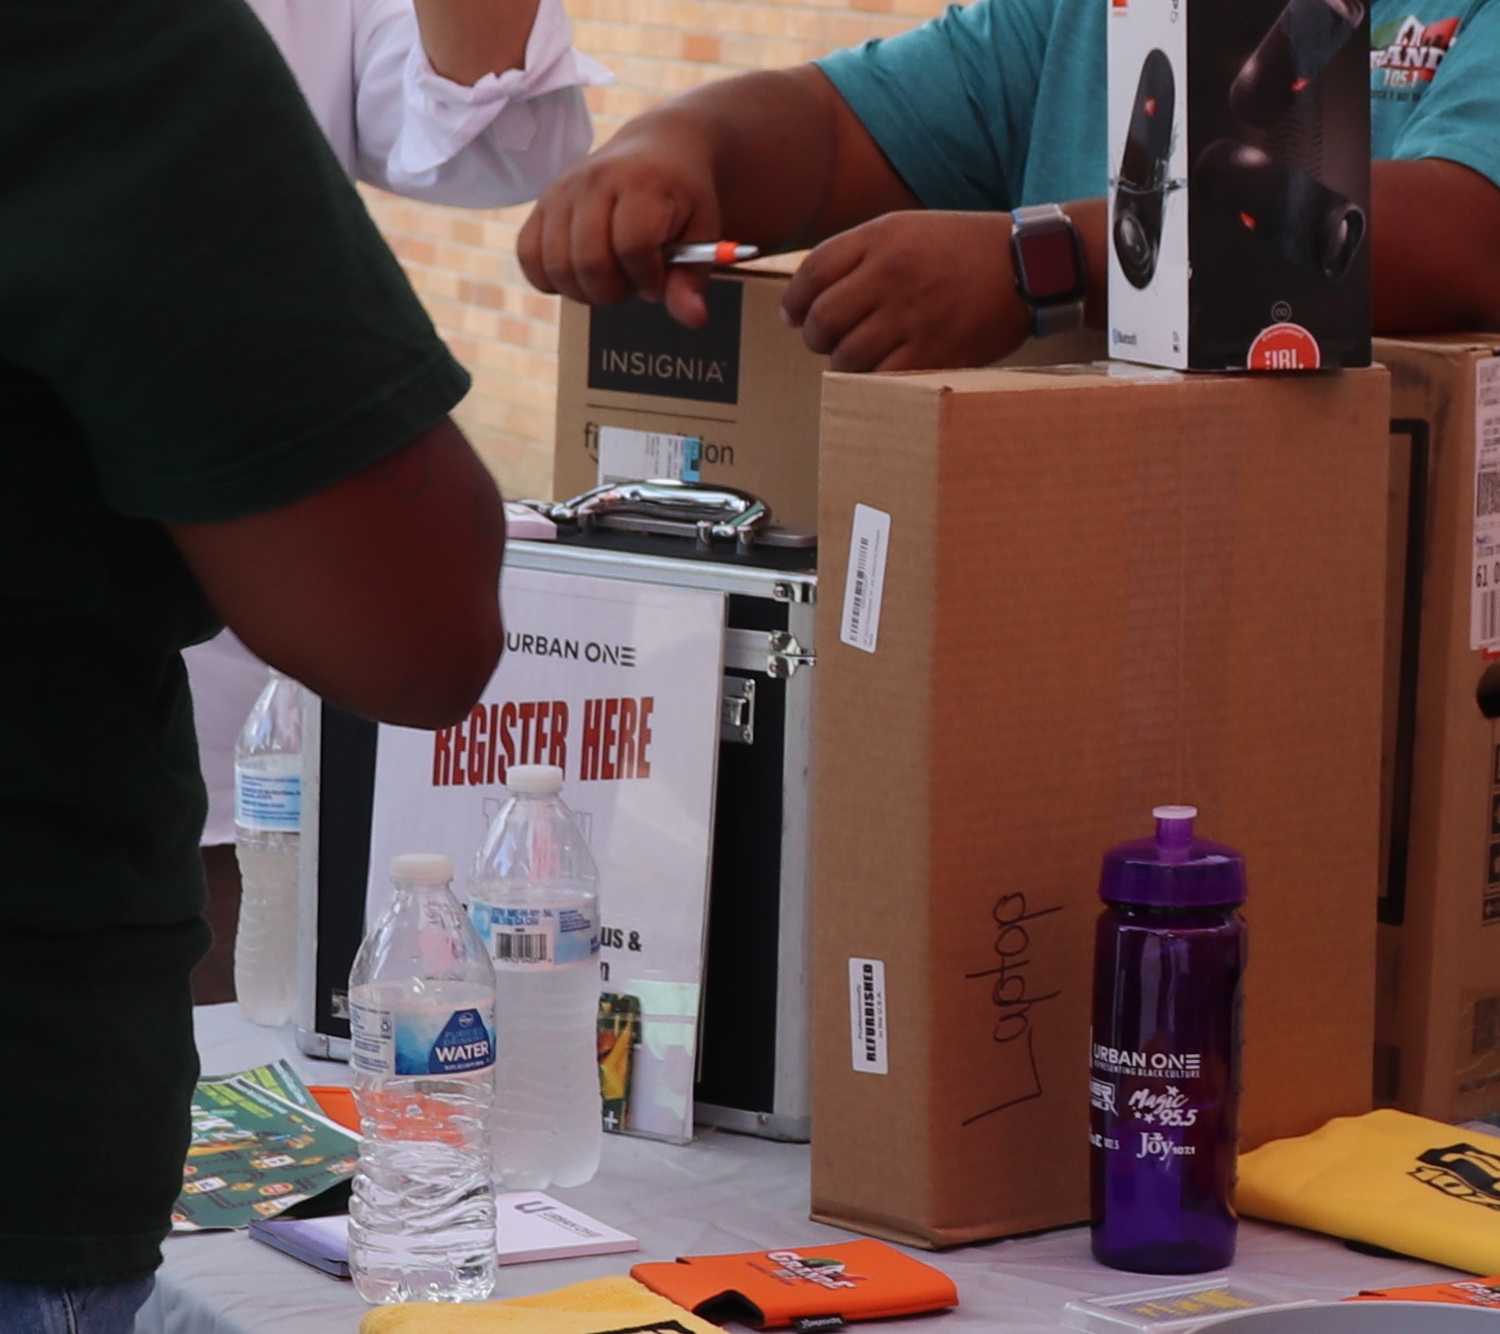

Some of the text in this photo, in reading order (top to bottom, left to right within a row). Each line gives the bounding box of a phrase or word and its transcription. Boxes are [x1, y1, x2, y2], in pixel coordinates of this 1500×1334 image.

[601, 349, 724, 384] INSIGNIA
[506, 631, 637, 668] URBAN ONE
[431, 696, 654, 787] REGISTER HERE
[863, 963, 876, 1062] REFURBISHED
[962, 890, 1063, 1128] Laptop
[435, 1041, 490, 1063] WATER
[1093, 1042, 1201, 1070] URBAN ONE
[1138, 1067, 1164, 1078] BLACK
[1165, 1068, 1201, 1079] CULTURE
[1128, 1087, 1190, 1115] Magic
[1159, 1108, 1199, 1127] 95.5
[1136, 1131, 1196, 1161] Joy 107.1
